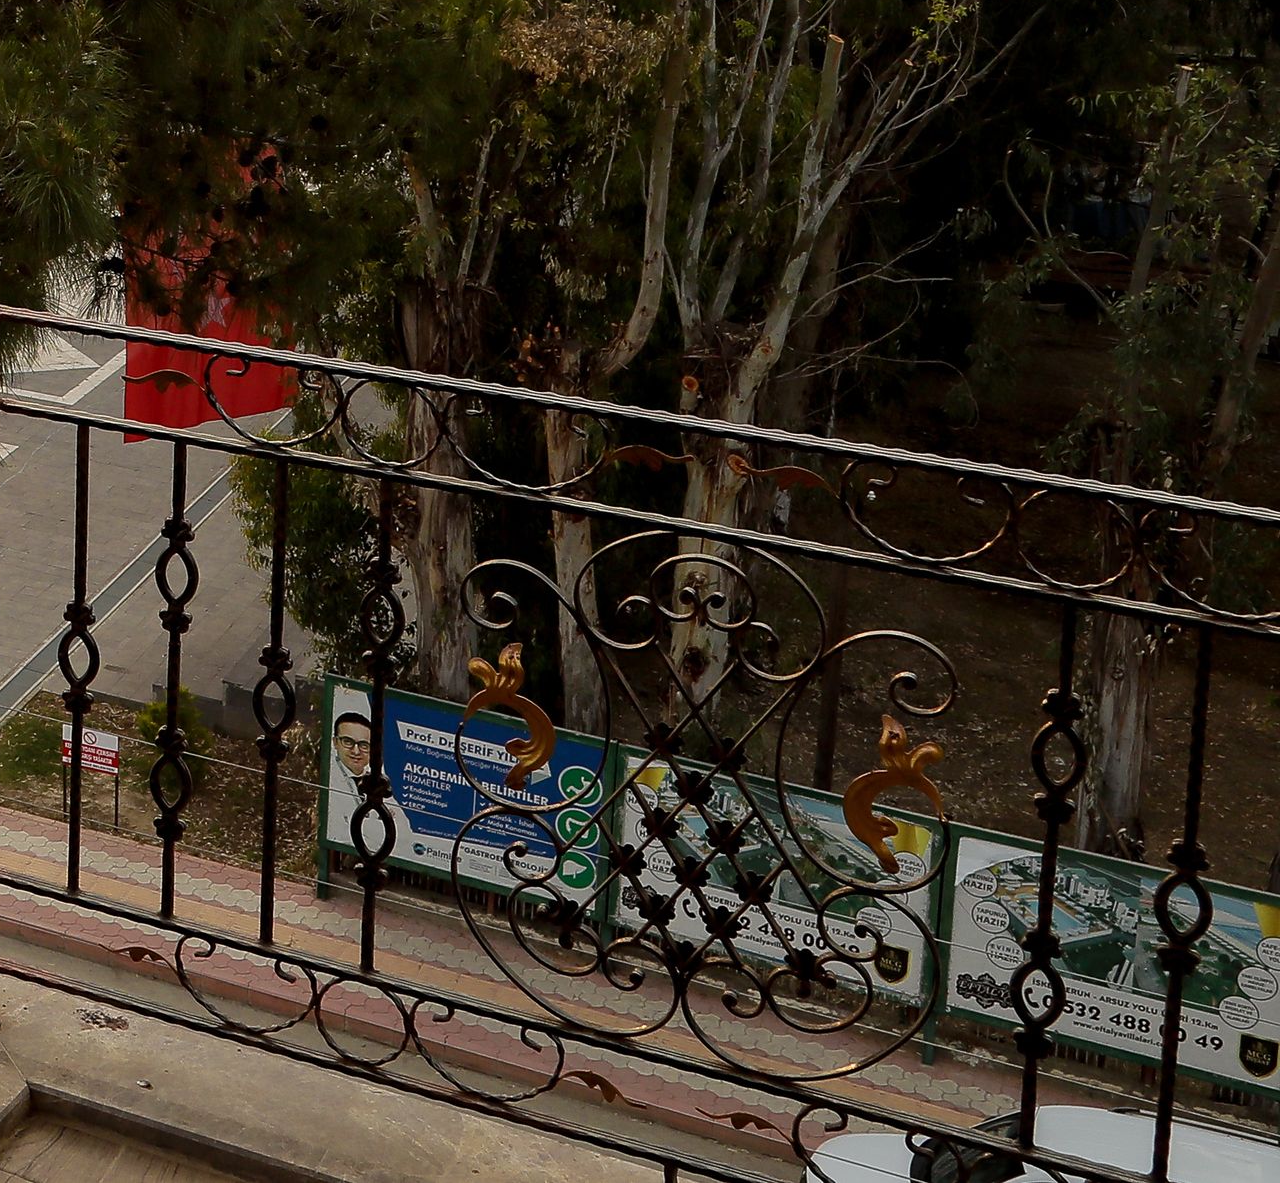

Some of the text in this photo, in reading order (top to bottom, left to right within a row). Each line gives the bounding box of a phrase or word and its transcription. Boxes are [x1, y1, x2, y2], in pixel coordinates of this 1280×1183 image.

[406, 729, 434, 745] Prof.
[438, 737, 456, 749] Dr.
[459, 741, 494, 757] ŞERİF
[402, 773, 452, 792] HİZMETLER
[408, 786, 443, 800] Endoskopi
[481, 781, 549, 806] BELİRTİLER
[962, 878, 994, 893] HAZIR
[778, 913, 802, 926] YOLU
[976, 914, 1007, 929] HAZIR
[1032, 977, 1091, 999] İSKEERUN
[1099, 995, 1130, 1009] ARSUZ
[1132, 1002, 1158, 1016] YOLU
[1191, 1018, 1219, 1031] 12.Km
[1062, 1000, 1101, 1021] 532
[1109, 1013, 1151, 1034] 488
[1195, 1034, 1224, 1052] 49
